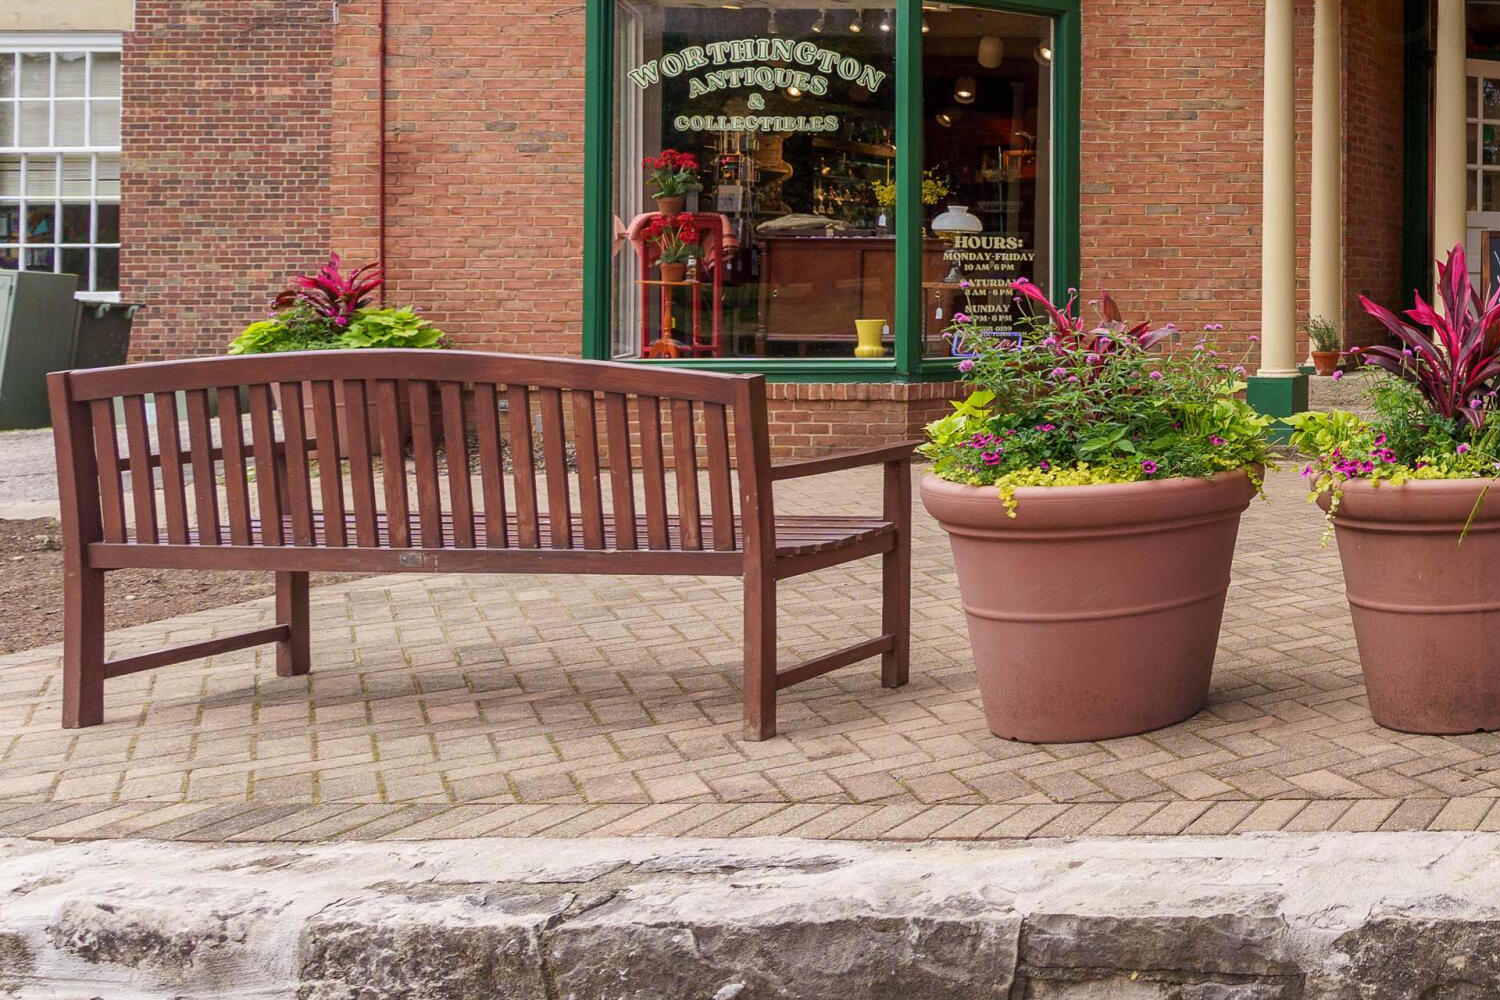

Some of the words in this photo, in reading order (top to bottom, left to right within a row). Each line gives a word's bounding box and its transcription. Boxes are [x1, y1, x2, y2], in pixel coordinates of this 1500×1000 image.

[627, 38, 886, 93] WORTHINGTON
[688, 66, 828, 99] ANTIQUES
[747, 92, 765, 110] &
[674, 115, 839, 132] COLLECTIBLES
[953, 235, 1024, 249] HOURS:
[943, 252, 1035, 261] MONDAY-FRIDAY
[964, 263, 974, 271] 10
[1001, 263, 1015, 271] PM
[971, 288, 987, 296] AM
[999, 288, 1014, 296] PM
[965, 304, 1011, 313] SUNDAY
[999, 314, 1013, 322] PM
